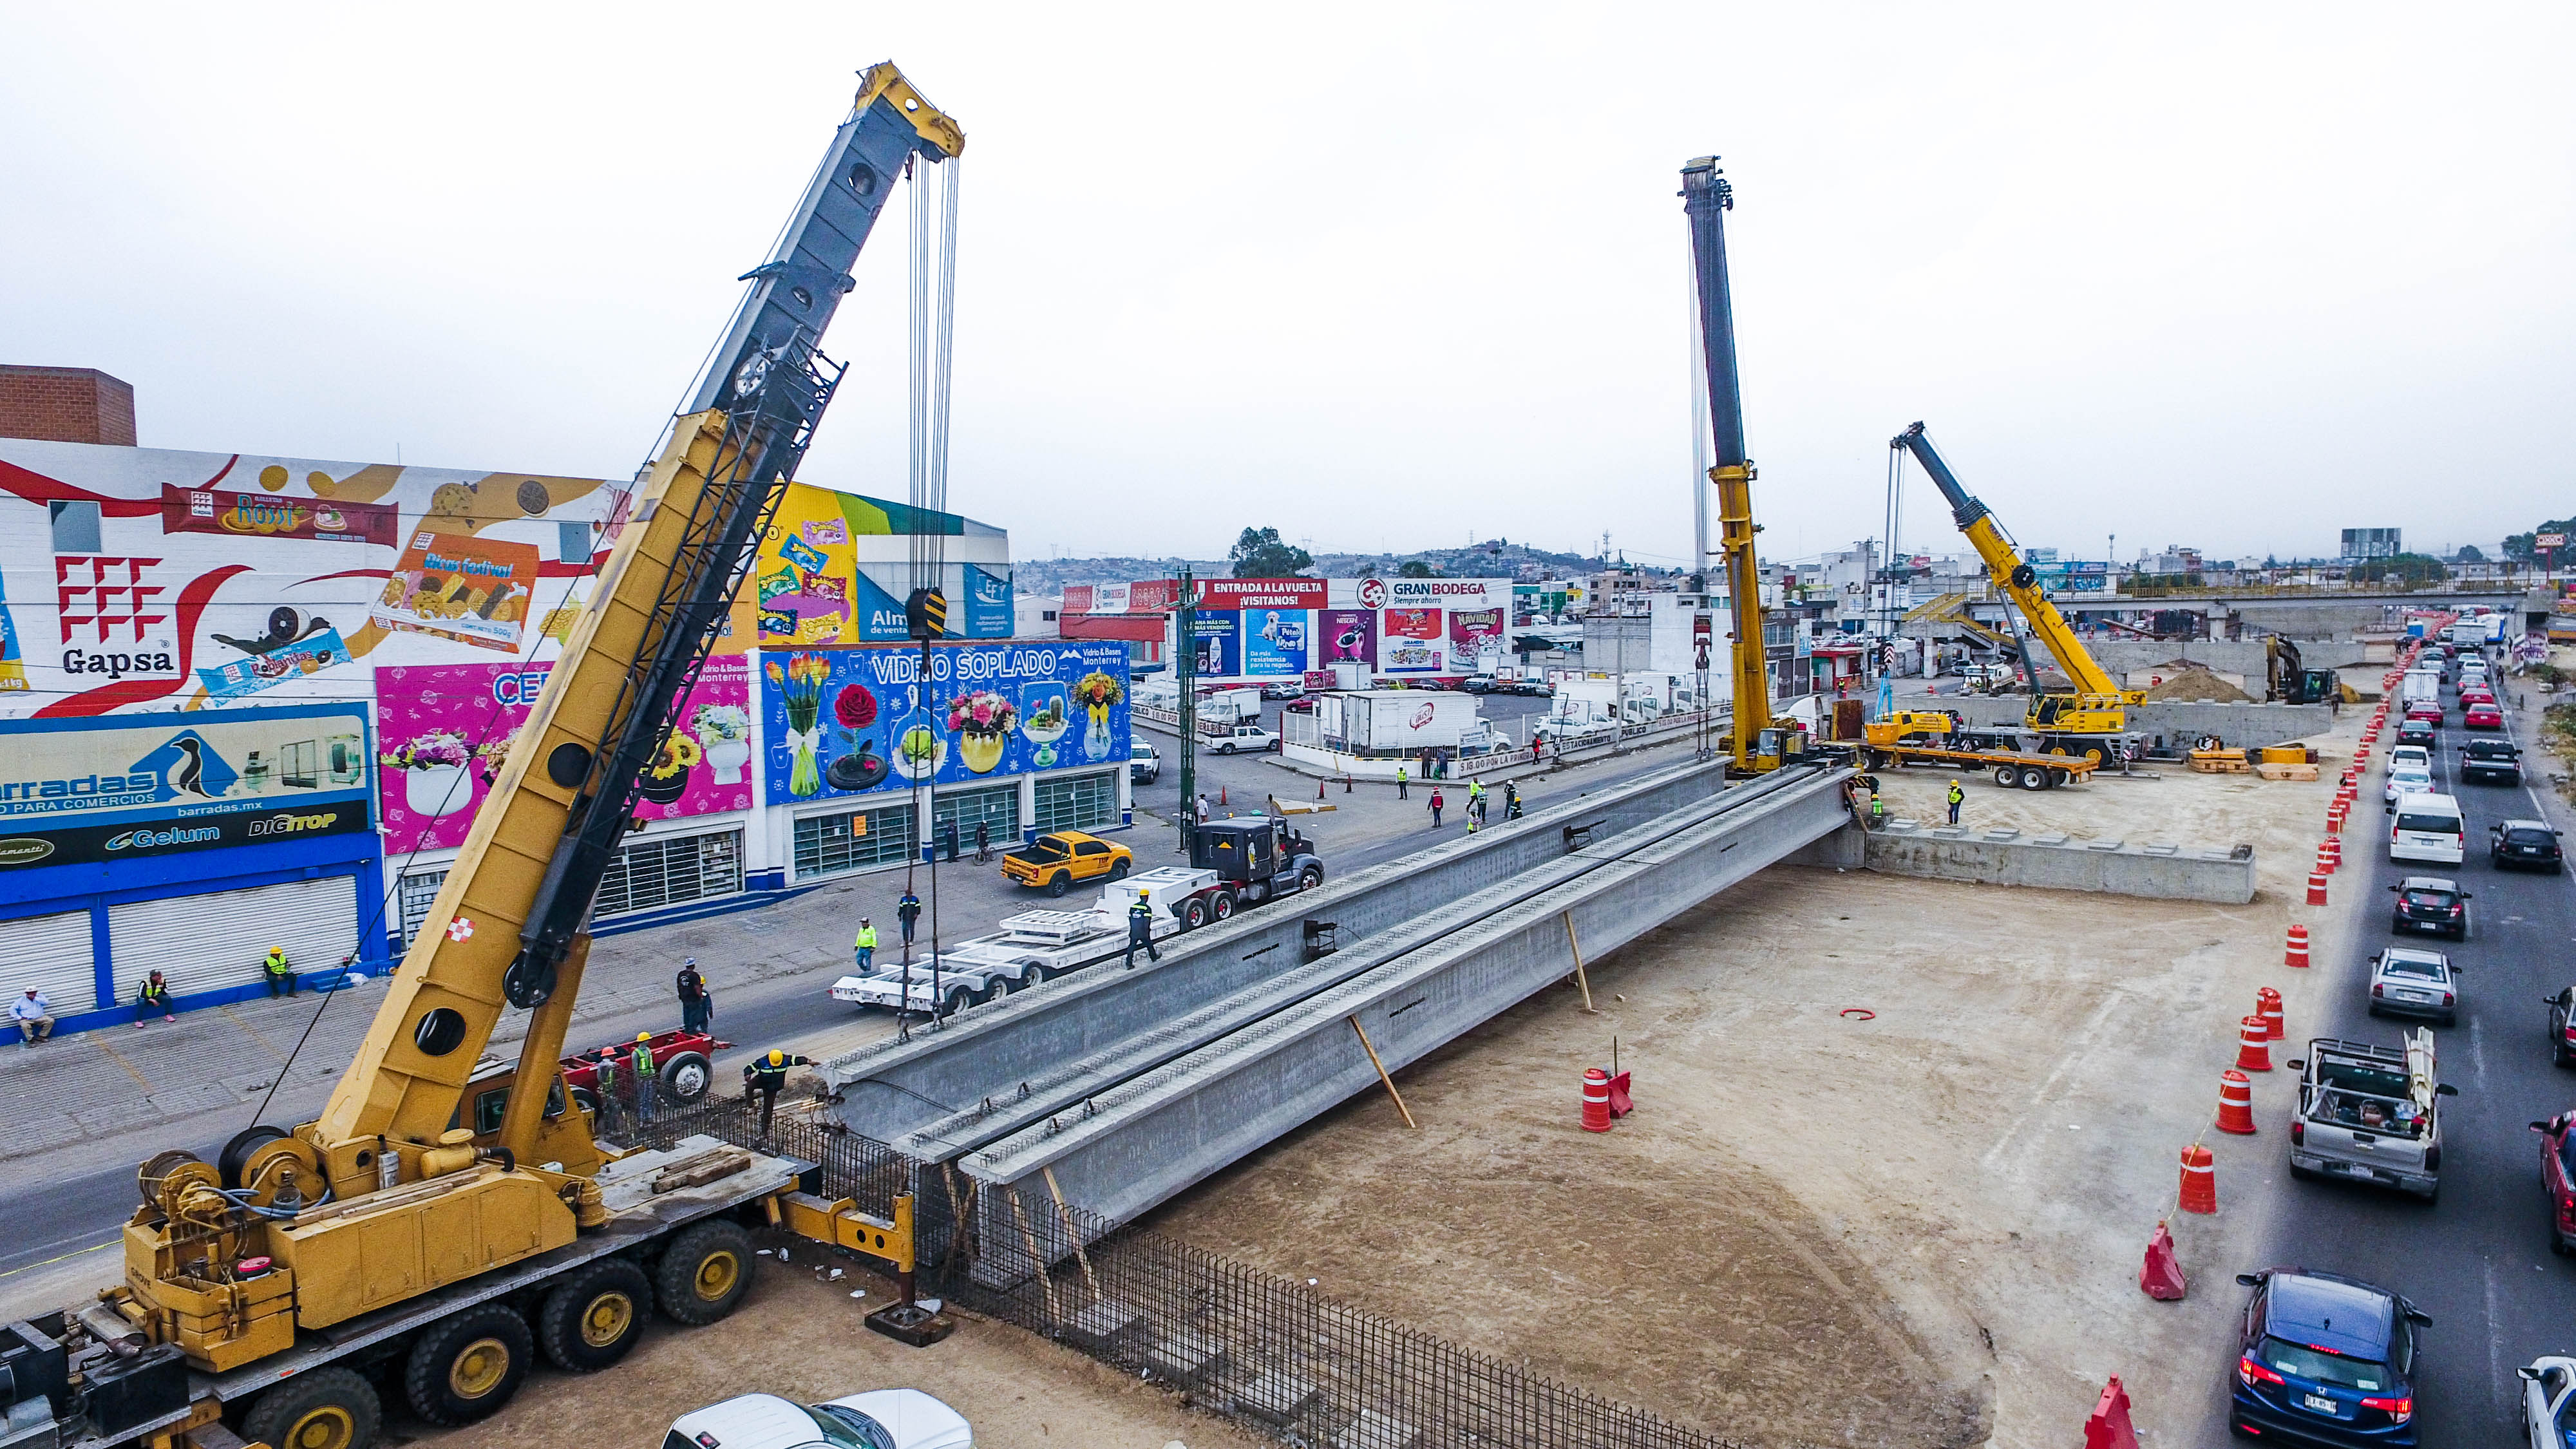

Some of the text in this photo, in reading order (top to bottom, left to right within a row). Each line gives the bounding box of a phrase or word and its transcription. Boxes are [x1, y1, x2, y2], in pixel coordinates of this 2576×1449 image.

[238, 495, 293, 526] Rossi
[2537, 536, 2563, 544] OXXO
[424, 553, 461, 571] Ricas
[1214, 583, 1263, 593] ENTRADA
[1264, 583, 1271, 593] A
[1272, 583, 1285, 592] LA
[1285, 583, 1322, 592] VUELTA
[1394, 583, 1486, 594] GRAN BODEGA
[1240, 596, 1298, 608] ¡VISITANOS!
[1394, 596, 1419, 605] Siempre
[1457, 613, 1497, 626] NAVIDAD
[493, 627, 512, 639] 500g
[63, 649, 174, 679] Gapsa
[872, 649, 1056, 685] VIDRO SOPLADO
[1083, 656, 1122, 665] Monterrey
[10, 678, 23, 688] kg
[697, 674, 748, 683] Monterrey
[1132, 706, 1149, 716] UBLICO
[1168, 714, 1177, 723] POR
[1460, 762, 1464, 772] $
[1486, 757, 1498, 767] POR
[1500, 755, 1508, 764] LA
[1539, 748, 1549, 757] ORA
[0, 773, 155, 801] rradas
[14, 802, 57, 813] PARA
[62, 793, 155, 810] COMERCIOS
[178, 800, 263, 817] barradas.mx
[249, 813, 337, 837] DIGITOP
[132, 826, 220, 848] Gelum
[0, 844, 45, 855] amantti
[131, 1267, 151, 1289] GROVE
